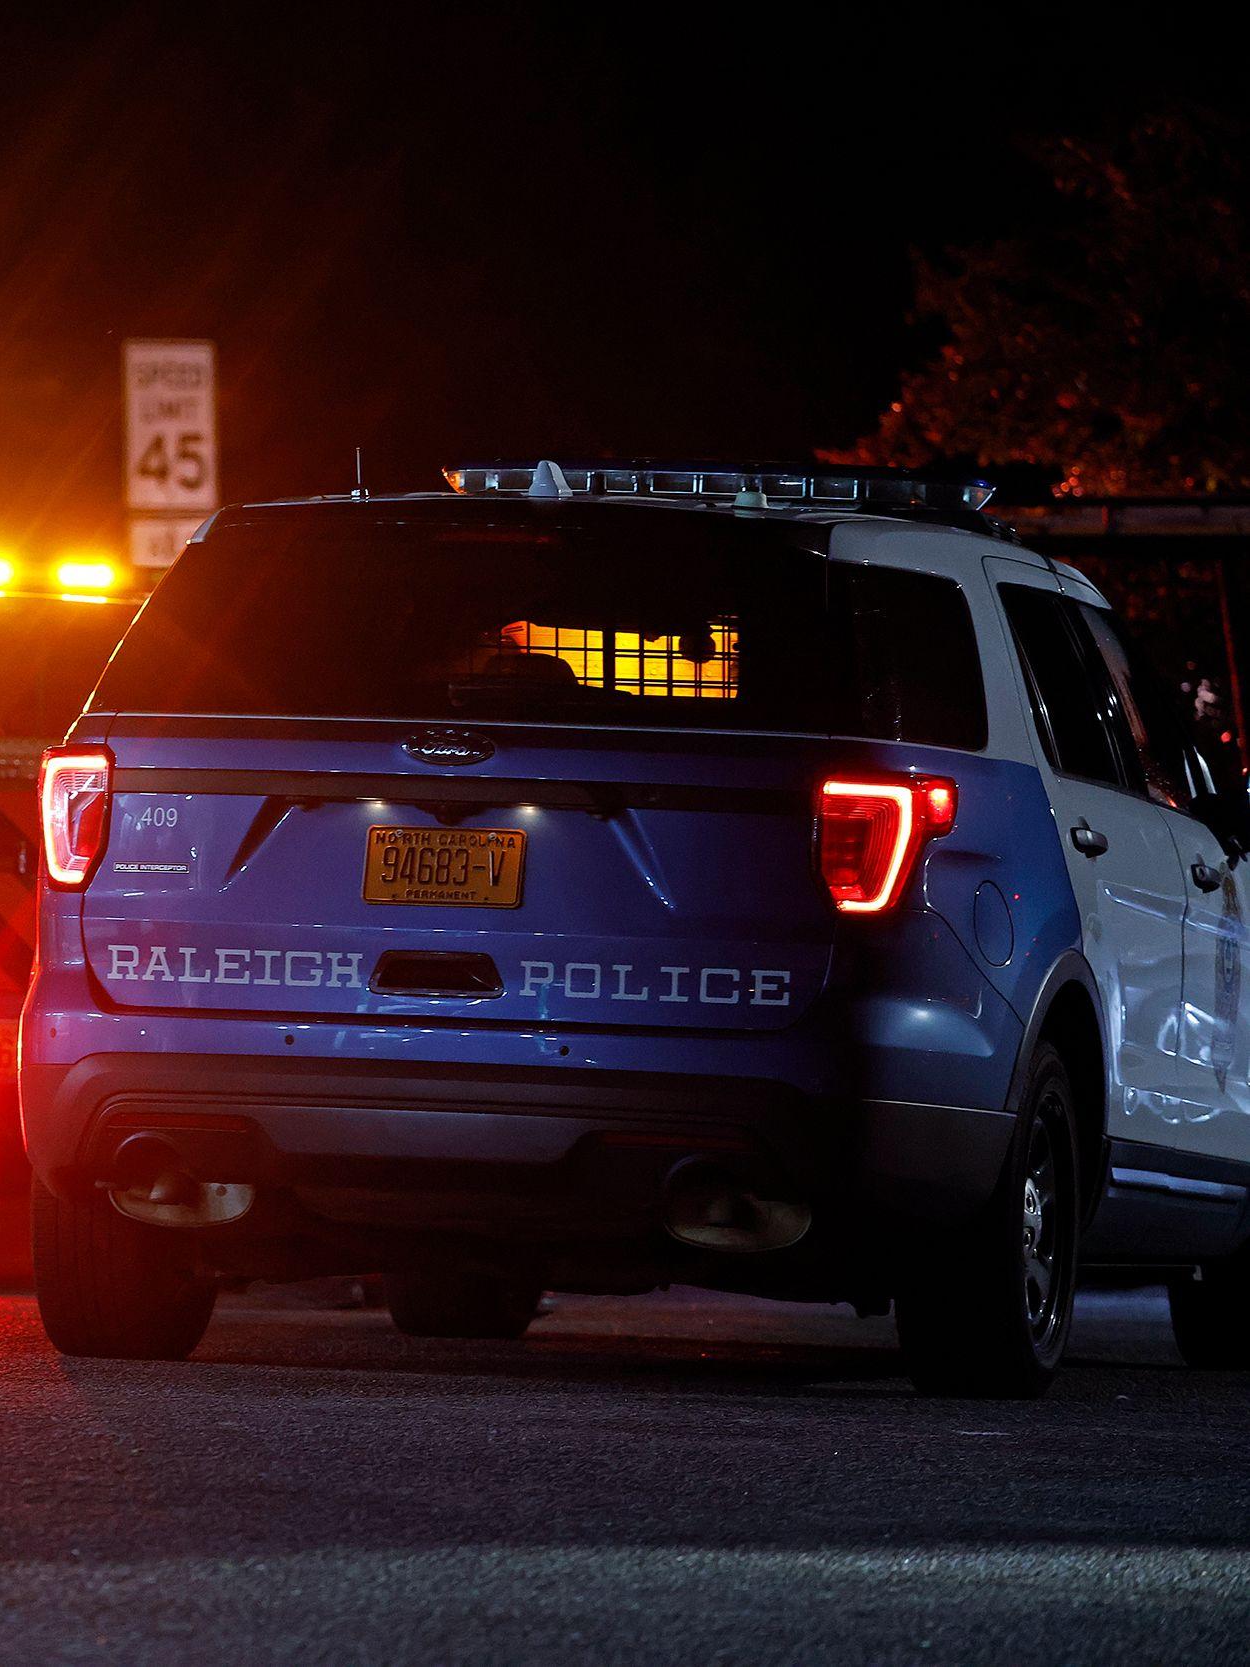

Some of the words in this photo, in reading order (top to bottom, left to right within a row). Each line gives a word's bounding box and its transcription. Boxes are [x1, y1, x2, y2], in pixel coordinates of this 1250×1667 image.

[136, 431, 205, 490] 45
[141, 807, 178, 828] 409
[375, 831, 431, 846] NORTH
[381, 845, 507, 887] 94683-V
[405, 889, 477, 900] PERMANENT
[107, 945, 363, 988] RALEIGH
[519, 960, 791, 1006] POLICE
